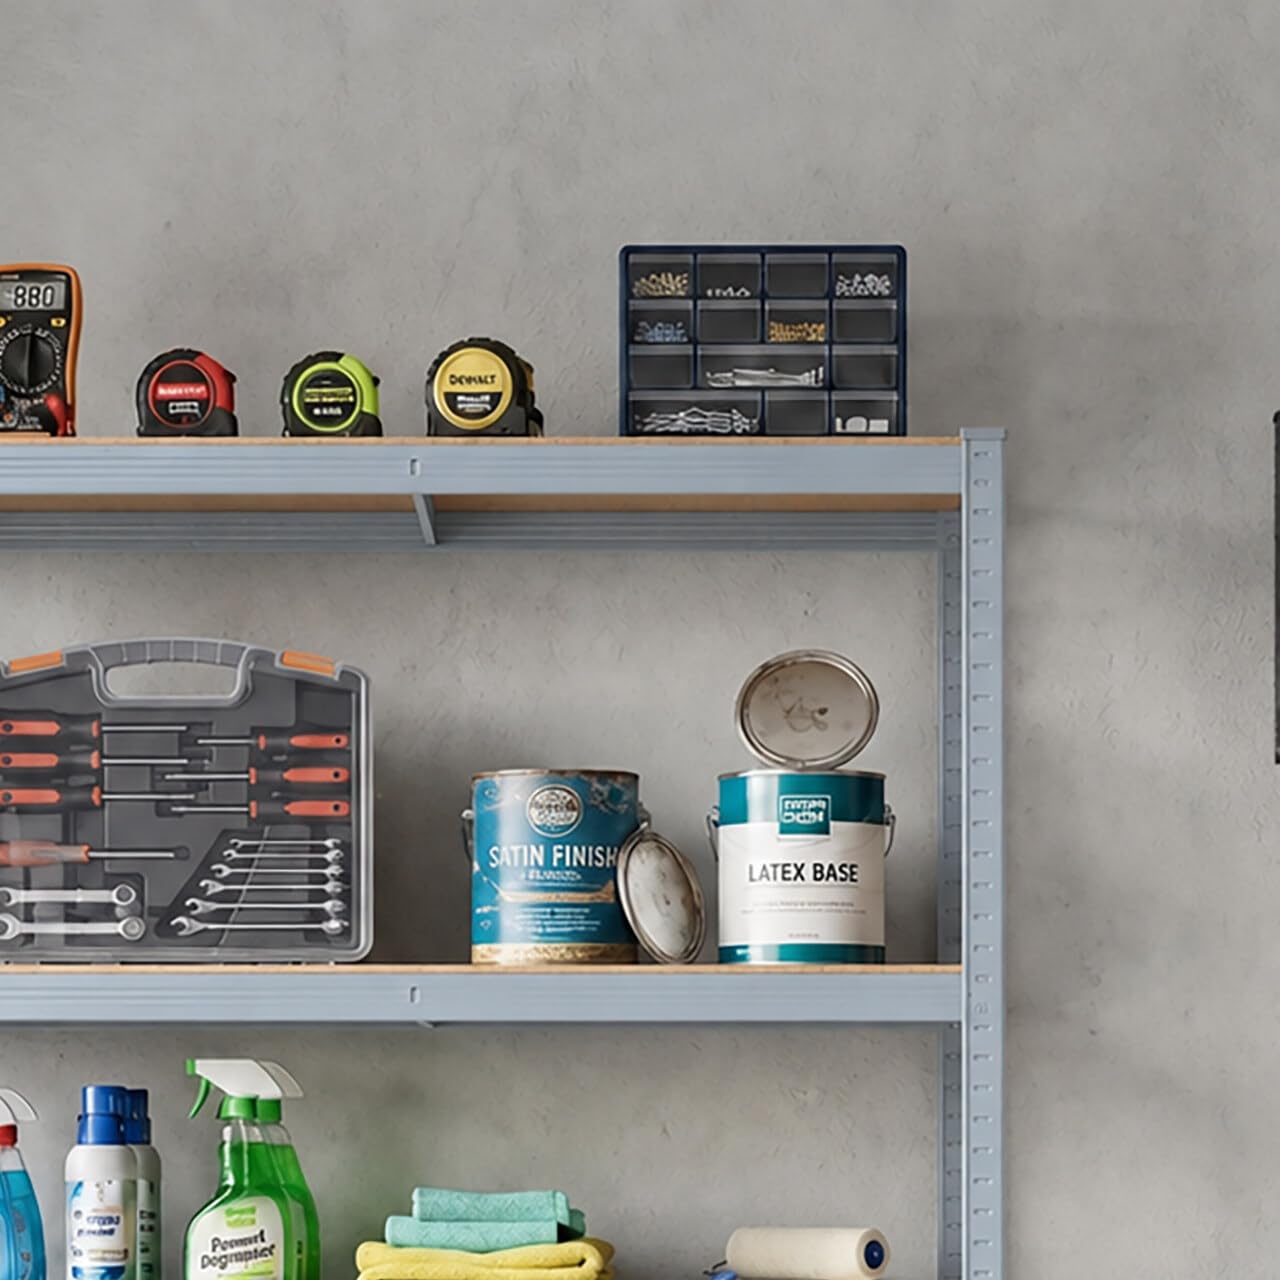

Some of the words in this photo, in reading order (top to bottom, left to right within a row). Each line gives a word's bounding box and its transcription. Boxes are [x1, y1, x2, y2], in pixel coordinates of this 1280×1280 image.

[489, 844, 545, 868] SATIN
[552, 844, 619, 868] FINISH
[748, 863, 806, 883] LATEX
[813, 863, 859, 883] BASE
